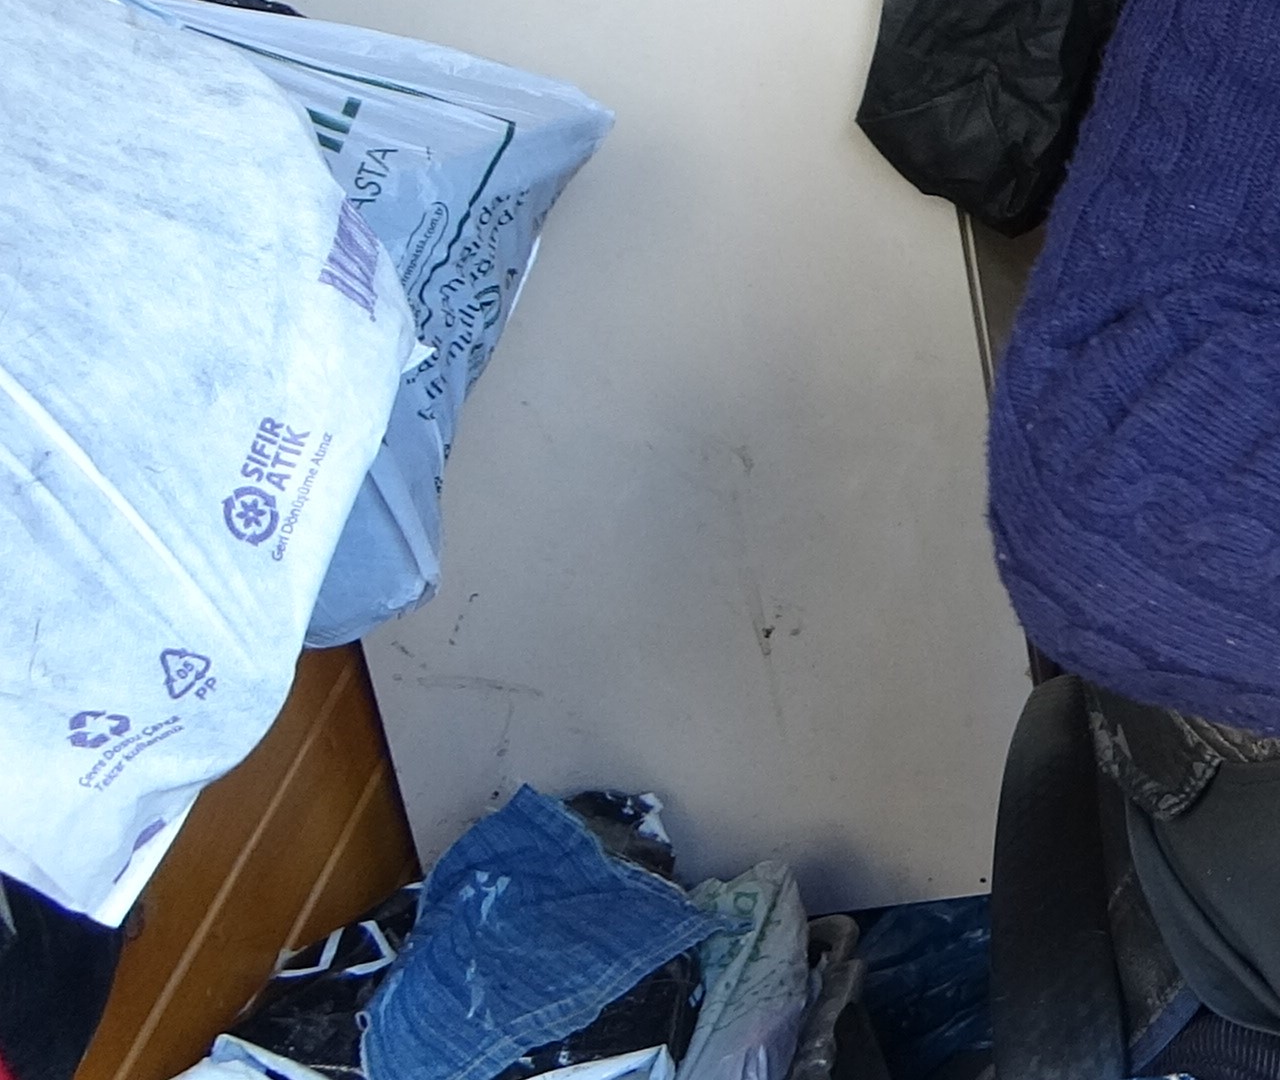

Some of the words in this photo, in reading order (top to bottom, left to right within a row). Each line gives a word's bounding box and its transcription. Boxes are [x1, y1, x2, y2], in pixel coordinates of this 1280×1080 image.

[353, 145, 398, 211] ASTA
[240, 416, 285, 482] SIFIR
[266, 424, 310, 492] ATIK
[270, 534, 290, 562] Geri
[283, 467, 319, 535] Dönüşüme
[194, 676, 217, 701] PP
